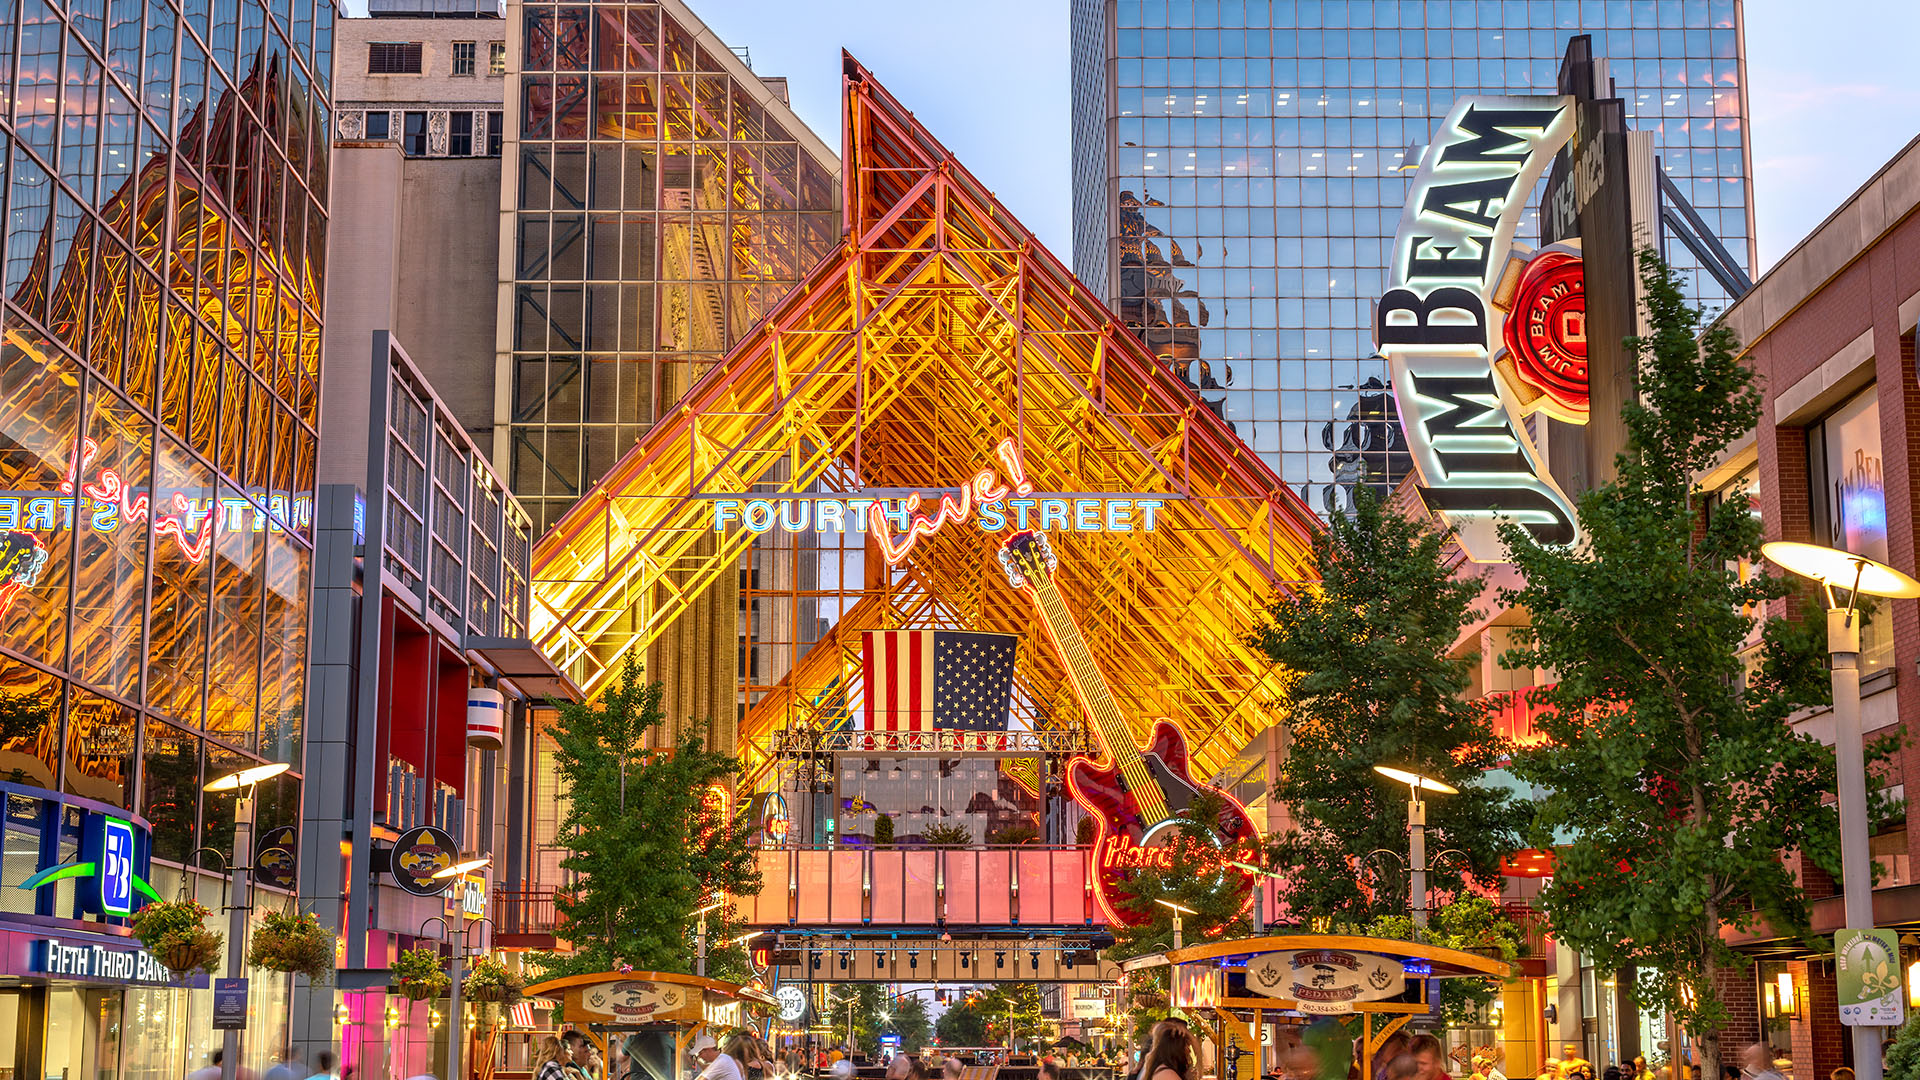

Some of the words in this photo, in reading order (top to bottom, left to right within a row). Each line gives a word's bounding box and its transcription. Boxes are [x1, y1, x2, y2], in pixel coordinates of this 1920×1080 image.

[1377, 102, 1567, 357] BEAM
[1531, 282, 1569, 337] BEAM
[1538, 345, 1572, 373] JIM
[1408, 369, 1577, 547] JIM
[713, 498, 910, 533] FOURTH
[977, 498, 1165, 534] STREET
[1104, 835, 1179, 868] Hard
[463, 881, 484, 914] obile
[47, 938, 89, 975] FIFTH
[92, 944, 134, 979] THIRD
[1299, 954, 1353, 967] THIRSTY
[1297, 988, 1353, 999] PEDALER
